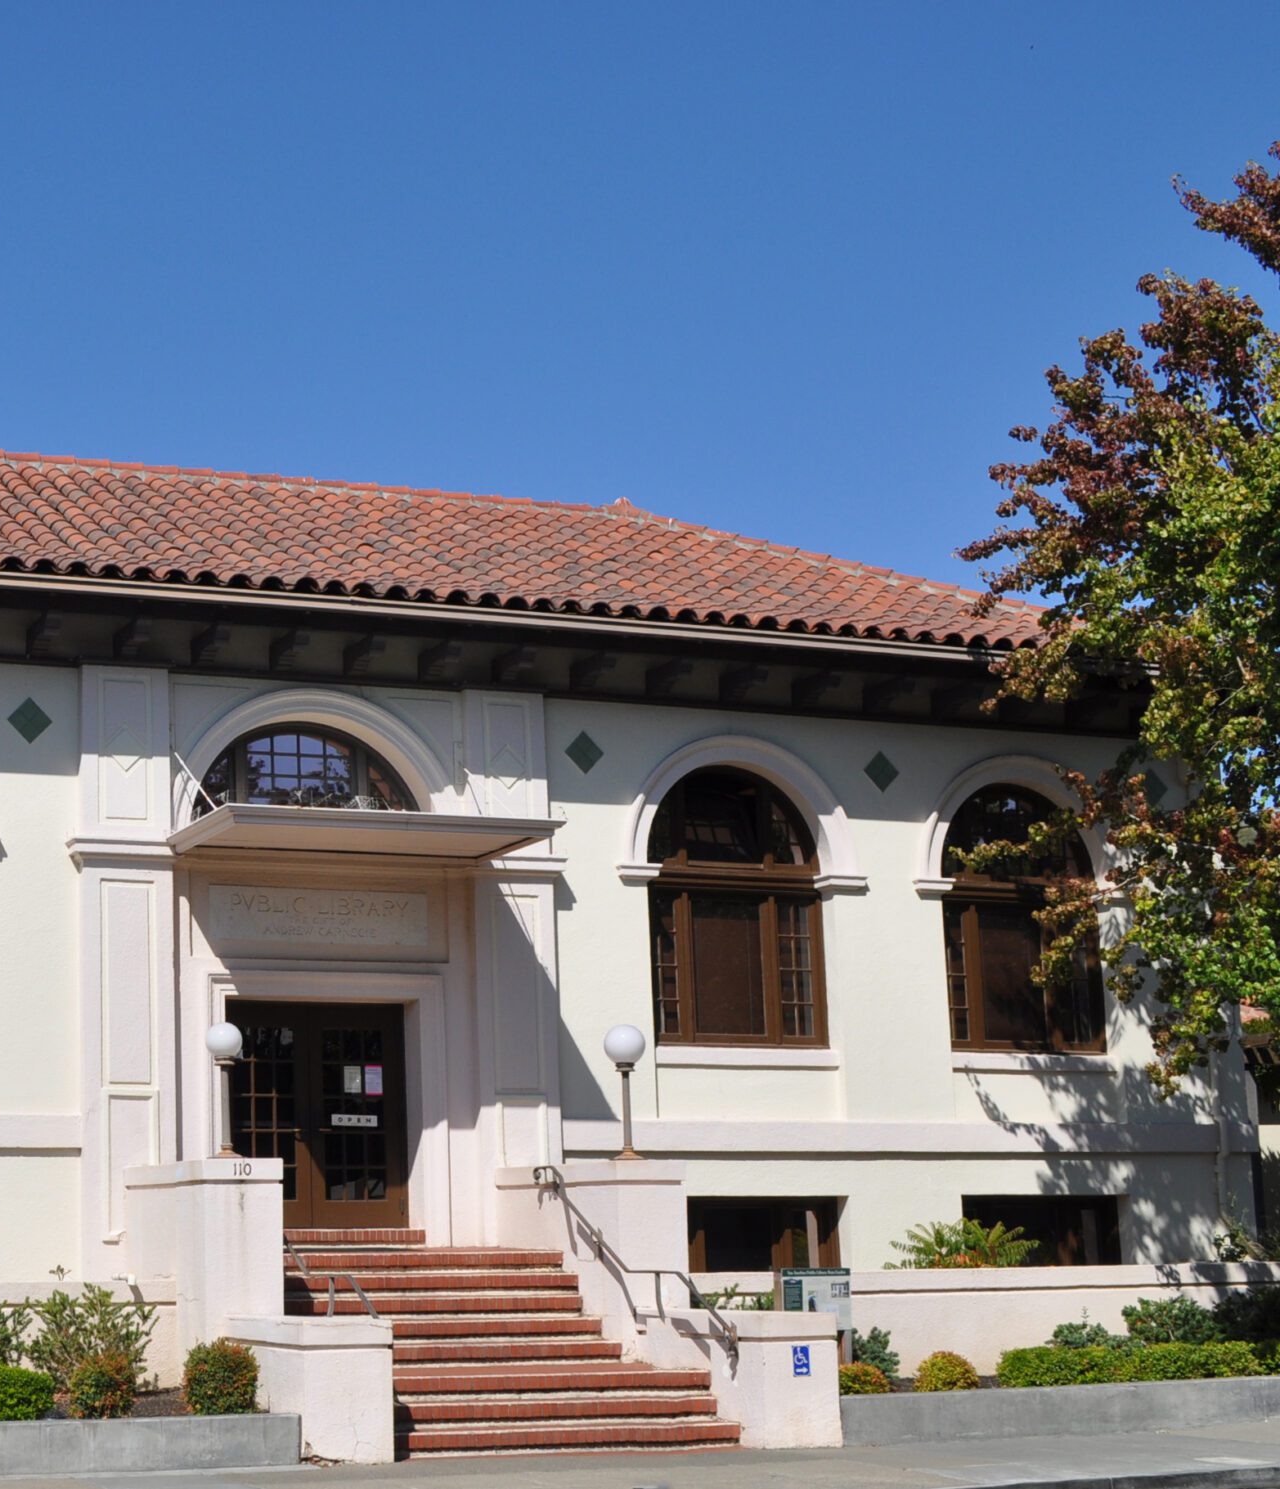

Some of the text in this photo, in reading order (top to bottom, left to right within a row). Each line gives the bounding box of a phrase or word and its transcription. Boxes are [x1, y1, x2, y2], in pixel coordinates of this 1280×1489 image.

[229, 892, 409, 918] PVBLIC LIBRARY
[262, 926, 314, 936] ANDREW
[337, 1116, 372, 1124] OPEN
[233, 1162, 252, 1176] 110
